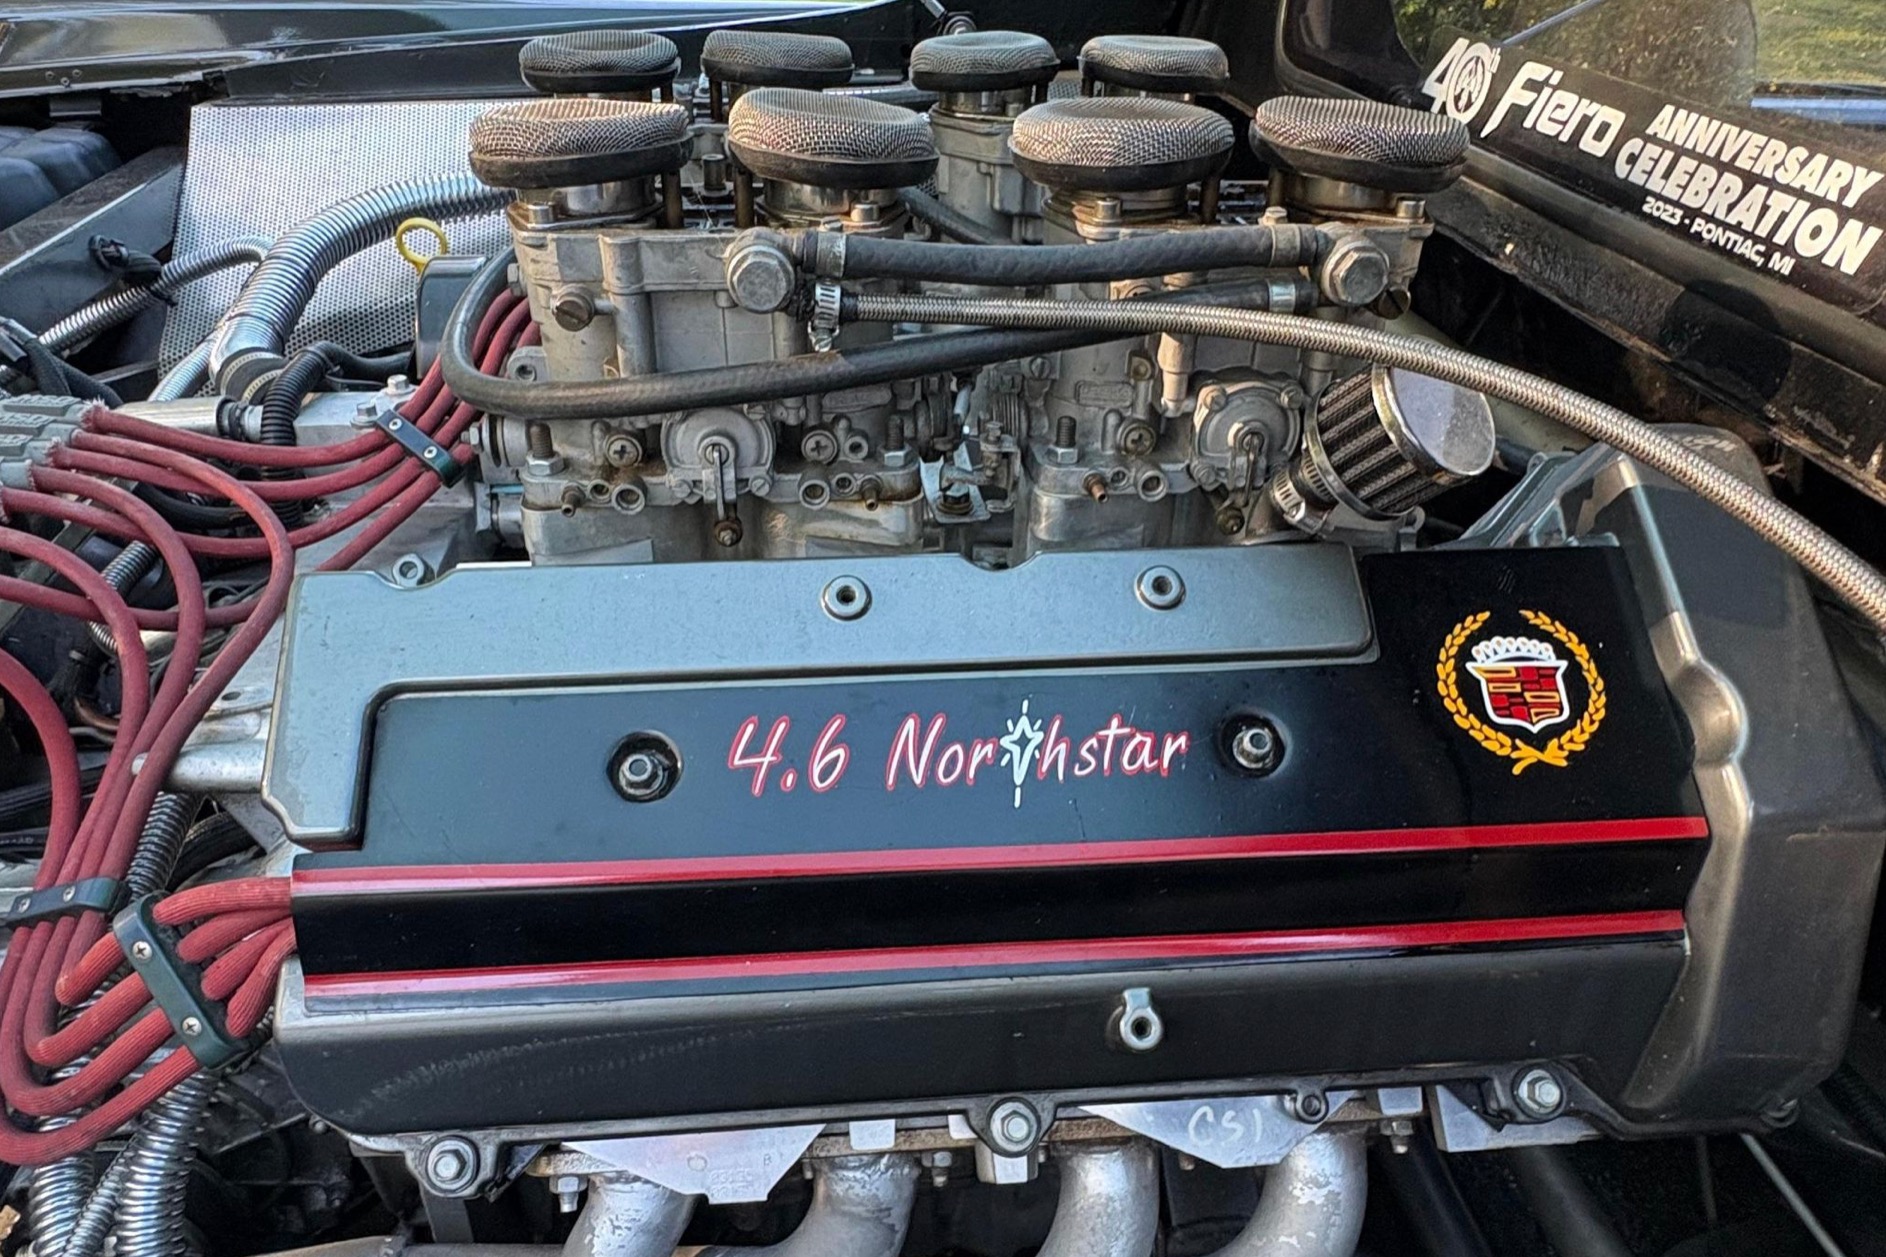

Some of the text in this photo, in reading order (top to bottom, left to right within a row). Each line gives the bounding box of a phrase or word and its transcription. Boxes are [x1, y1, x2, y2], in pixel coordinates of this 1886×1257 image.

[1479, 61, 1626, 158] Fiero
[1645, 104, 1885, 208] ANNIVERSARY
[1614, 137, 1884, 276] CELEBRATION
[1641, 196, 1684, 225] 2023
[1690, 217, 1766, 267] PONTIAC,
[1767, 250, 1796, 276] MI
[728, 714, 851, 798] 4.6
